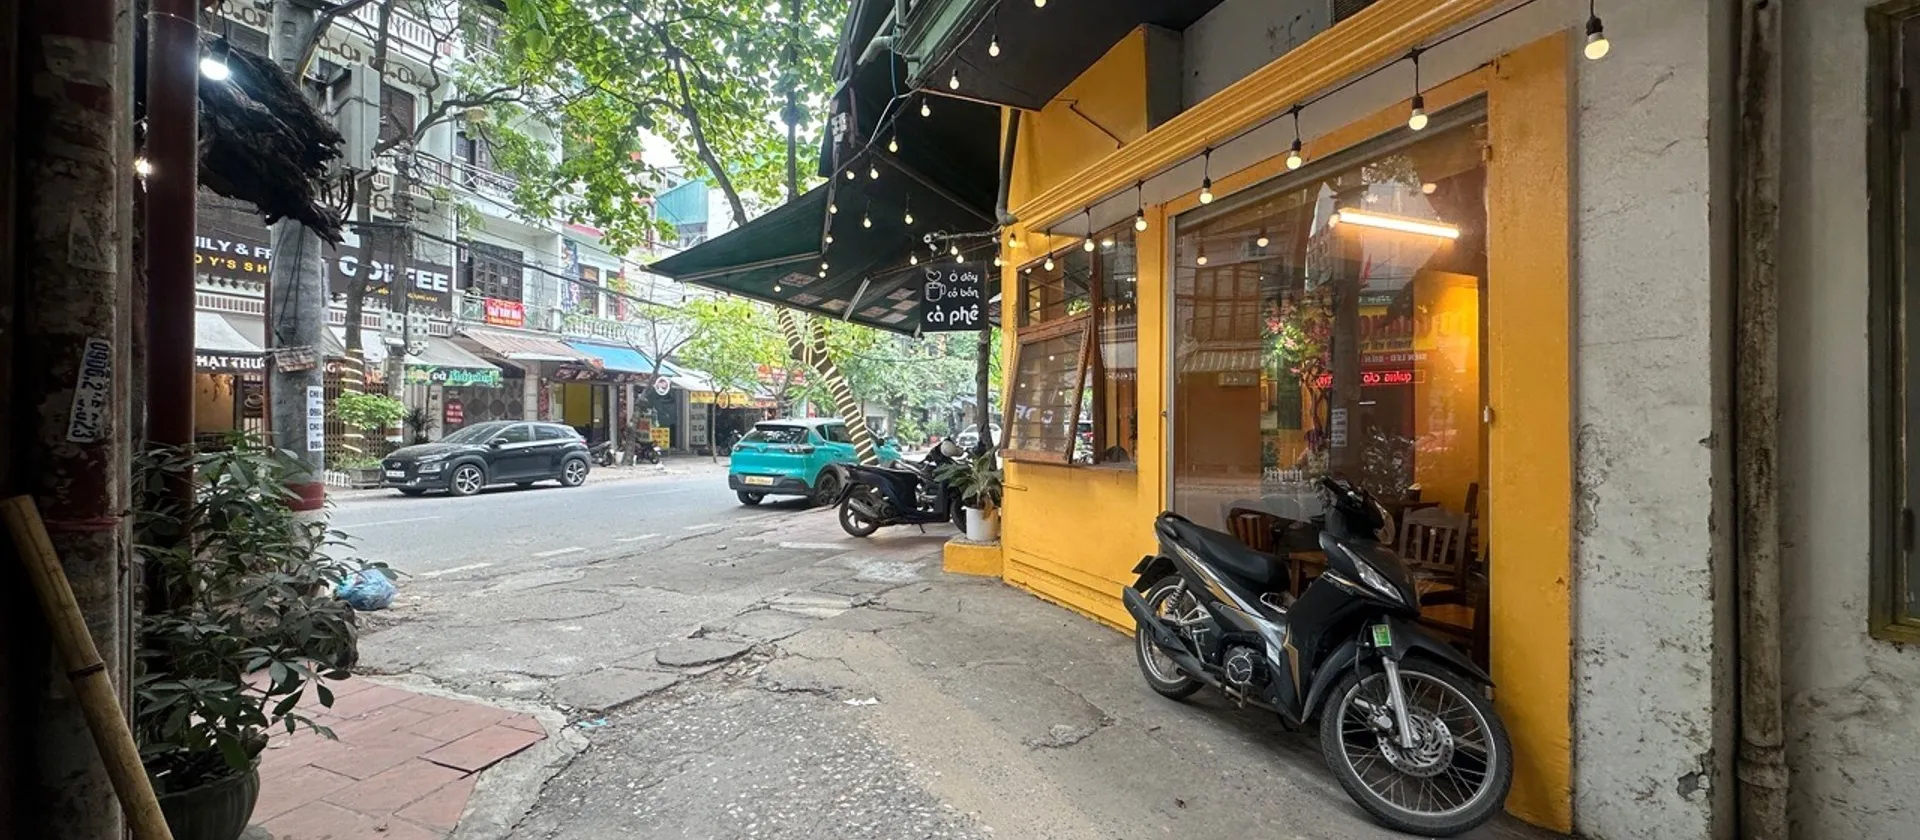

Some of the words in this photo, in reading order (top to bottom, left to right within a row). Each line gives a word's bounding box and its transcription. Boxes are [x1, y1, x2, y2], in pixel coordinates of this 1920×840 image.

[235, 243, 249, 256] &
[947, 286, 958, 298] có
[926, 304, 945, 323] cà
[949, 303, 979, 326] phê
